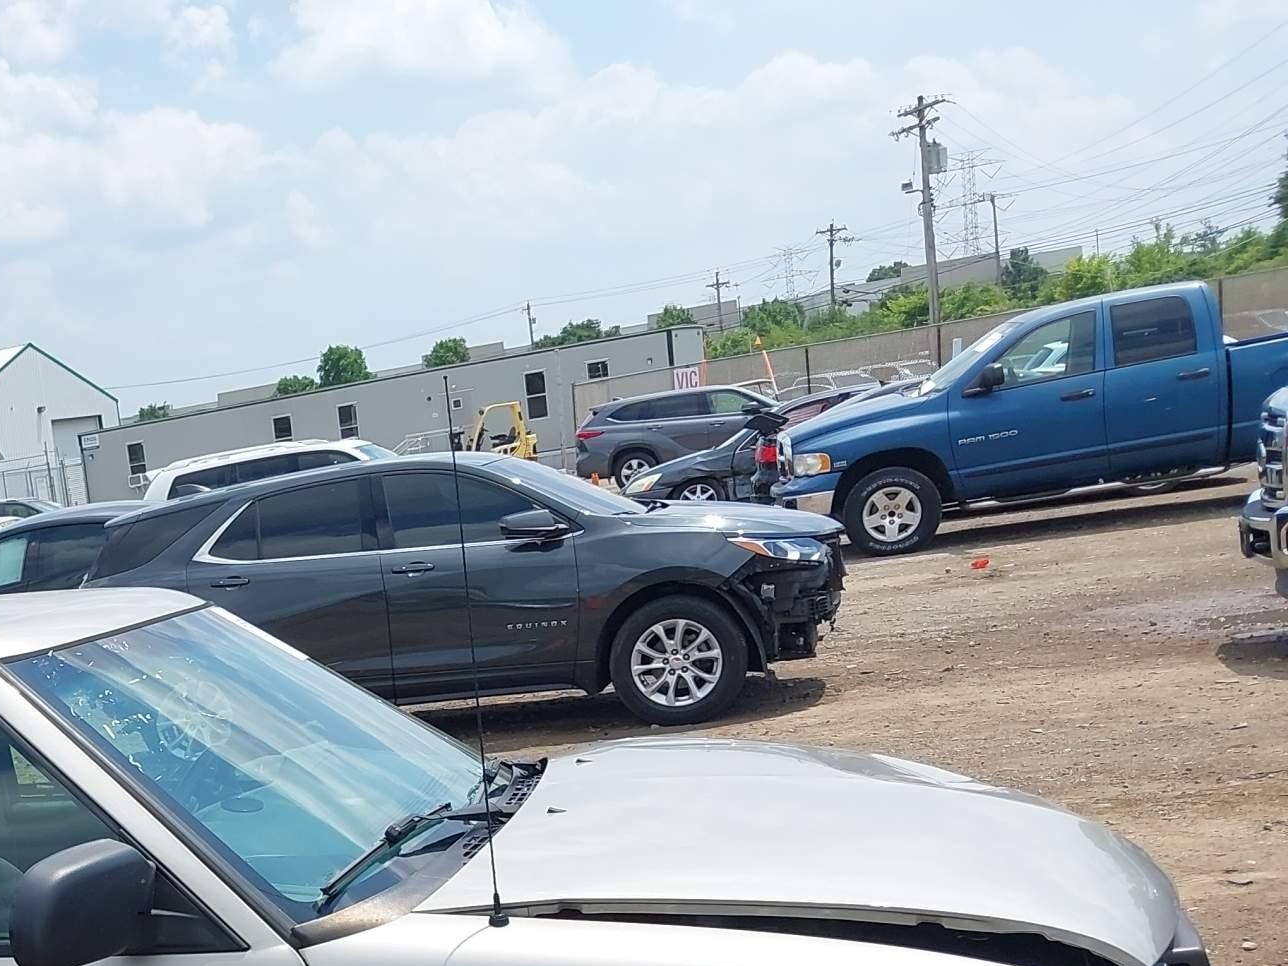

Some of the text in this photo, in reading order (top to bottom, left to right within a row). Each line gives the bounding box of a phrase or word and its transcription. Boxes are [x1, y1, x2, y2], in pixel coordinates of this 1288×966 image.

[676, 370, 698, 389] VIC
[958, 429, 1019, 446] RAM 1500
[506, 619, 568, 630] EQUINOX
